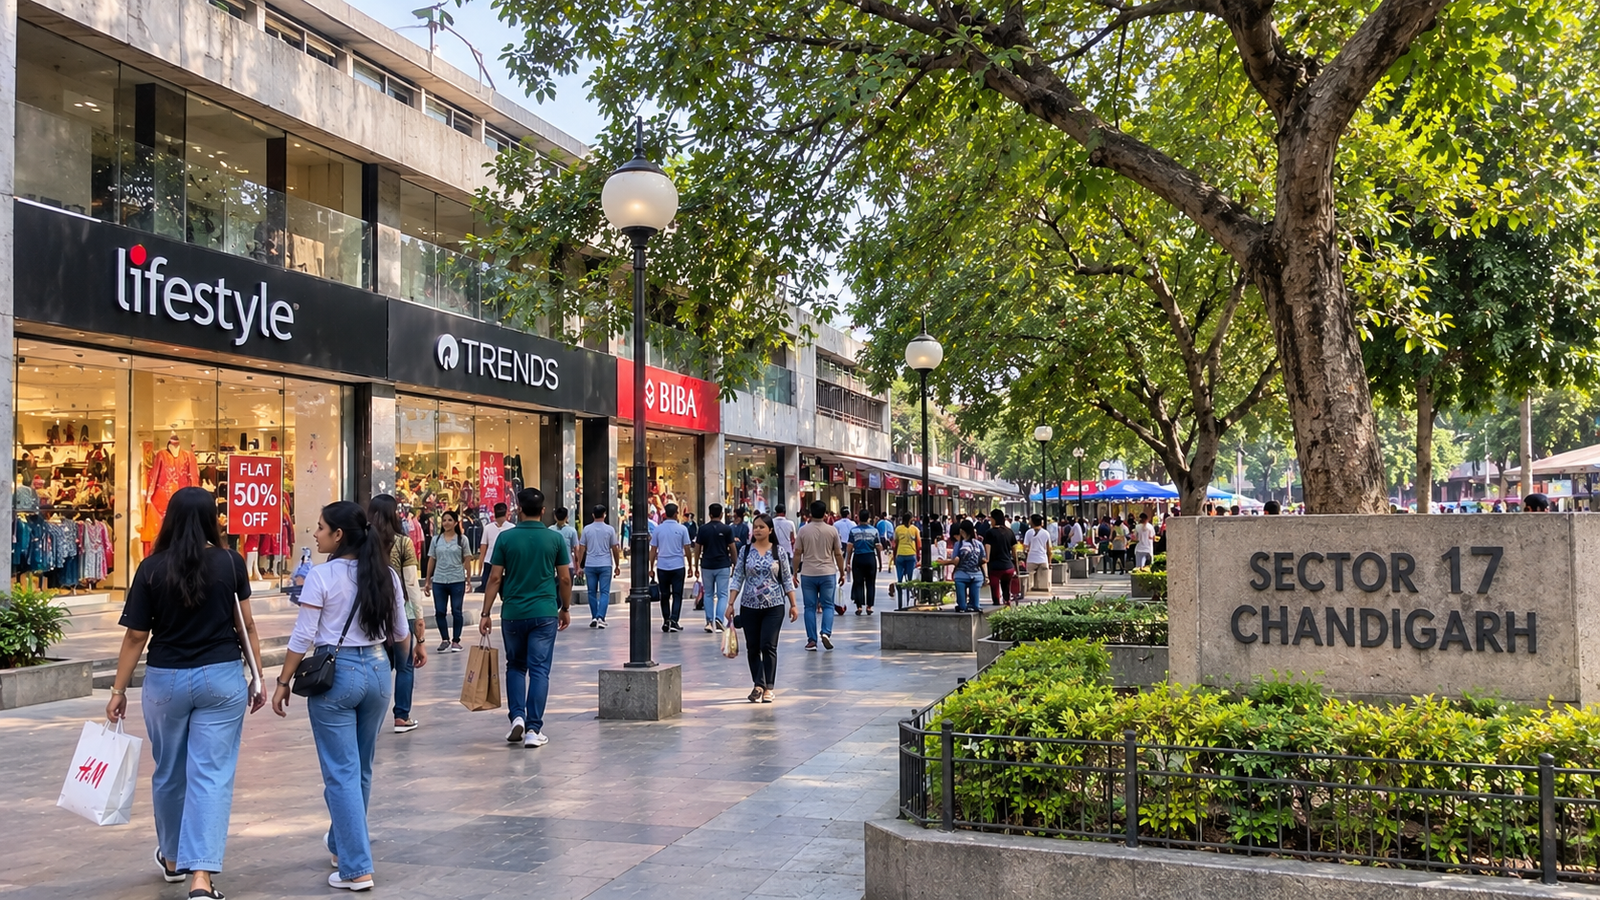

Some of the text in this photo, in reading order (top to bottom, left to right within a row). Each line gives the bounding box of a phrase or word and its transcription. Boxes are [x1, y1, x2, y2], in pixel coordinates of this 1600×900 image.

[117, 243, 294, 346] lifestyle
[461, 338, 559, 391] TRENDS
[658, 378, 698, 418] BIBA
[240, 462, 272, 477] FLAT
[233, 482, 277, 507] 50%
[242, 511, 269, 527] OFF
[1250, 546, 1503, 595] SECTOR 17
[1231, 604, 1537, 654] CHANDIGARH
